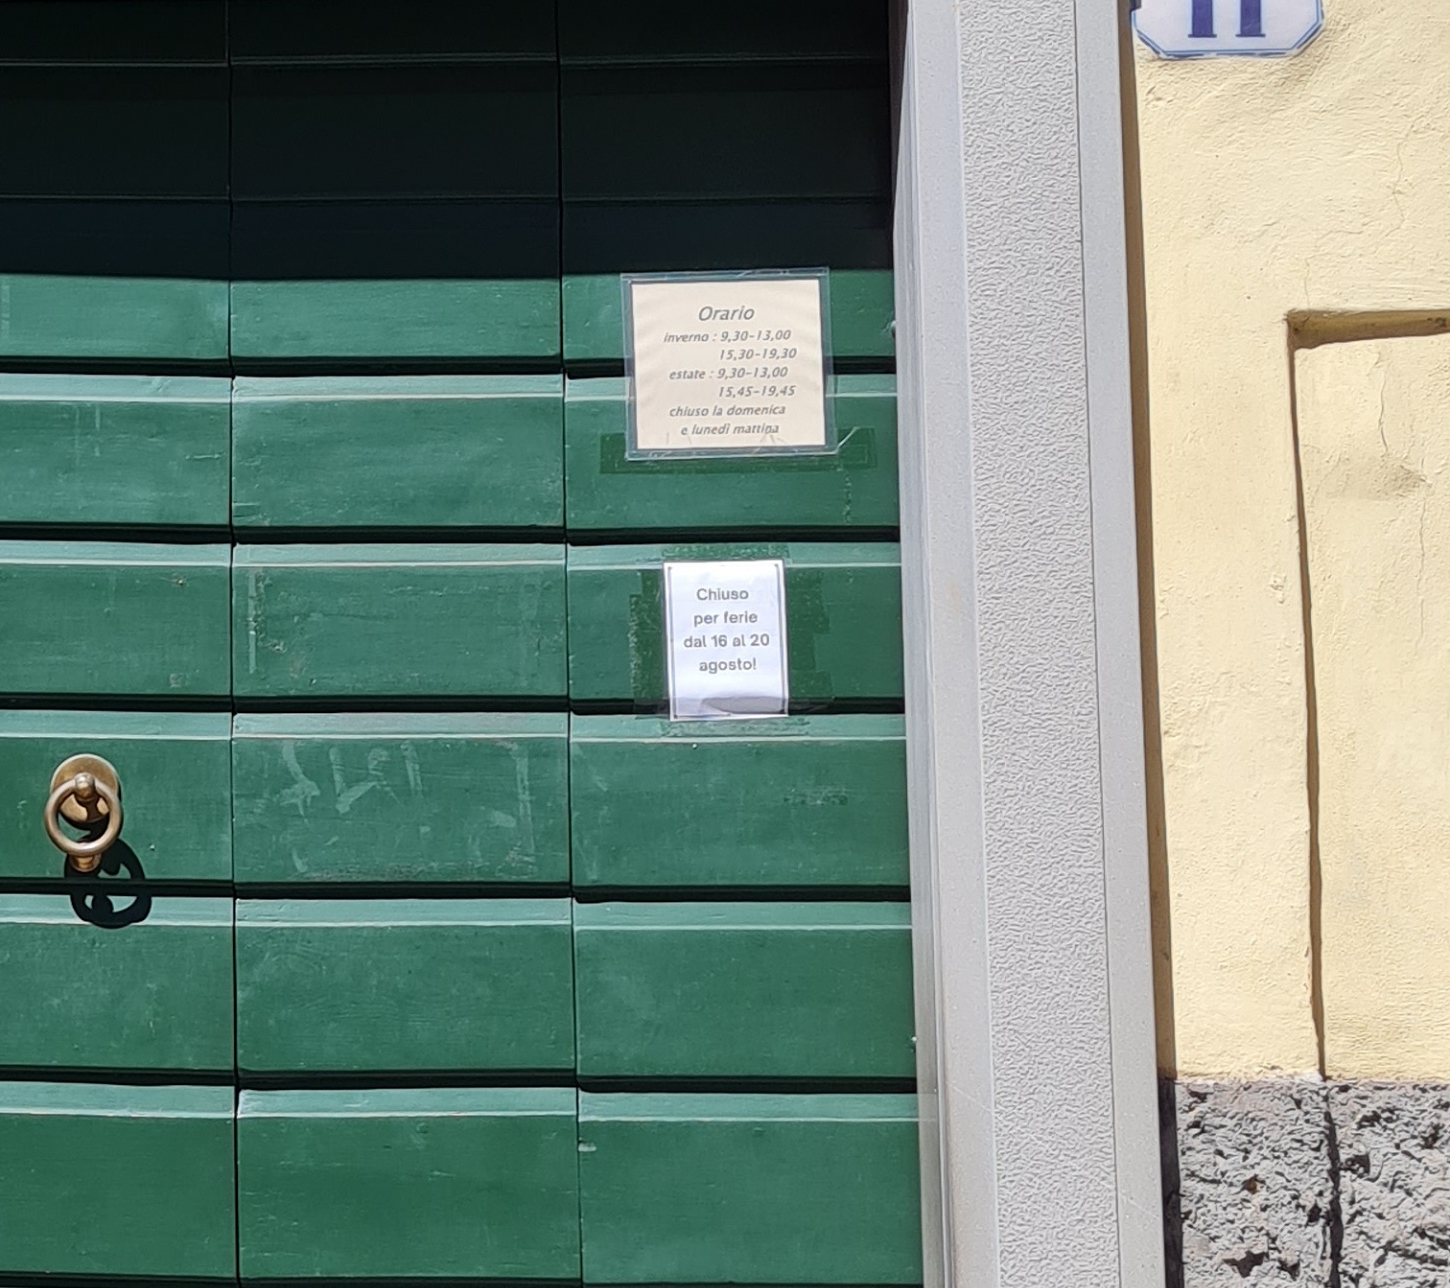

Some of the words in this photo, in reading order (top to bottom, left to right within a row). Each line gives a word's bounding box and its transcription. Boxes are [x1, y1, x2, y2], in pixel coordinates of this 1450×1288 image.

[698, 305, 755, 322] Orario
[663, 332, 710, 343] inverno
[669, 368, 706, 380] estate
[669, 405, 710, 417] chiuso
[712, 405, 723, 417] la
[726, 404, 786, 416] domenica
[732, 422, 780, 435] mattina
[696, 587, 750, 601] Chiuso
[693, 614, 720, 628] per
[723, 610, 758, 624] ferie
[683, 635, 707, 648] dal
[710, 634, 728, 648] 16
[732, 633, 746, 647] al
[749, 633, 770, 647] 20
[699, 657, 757, 675] agosto!
